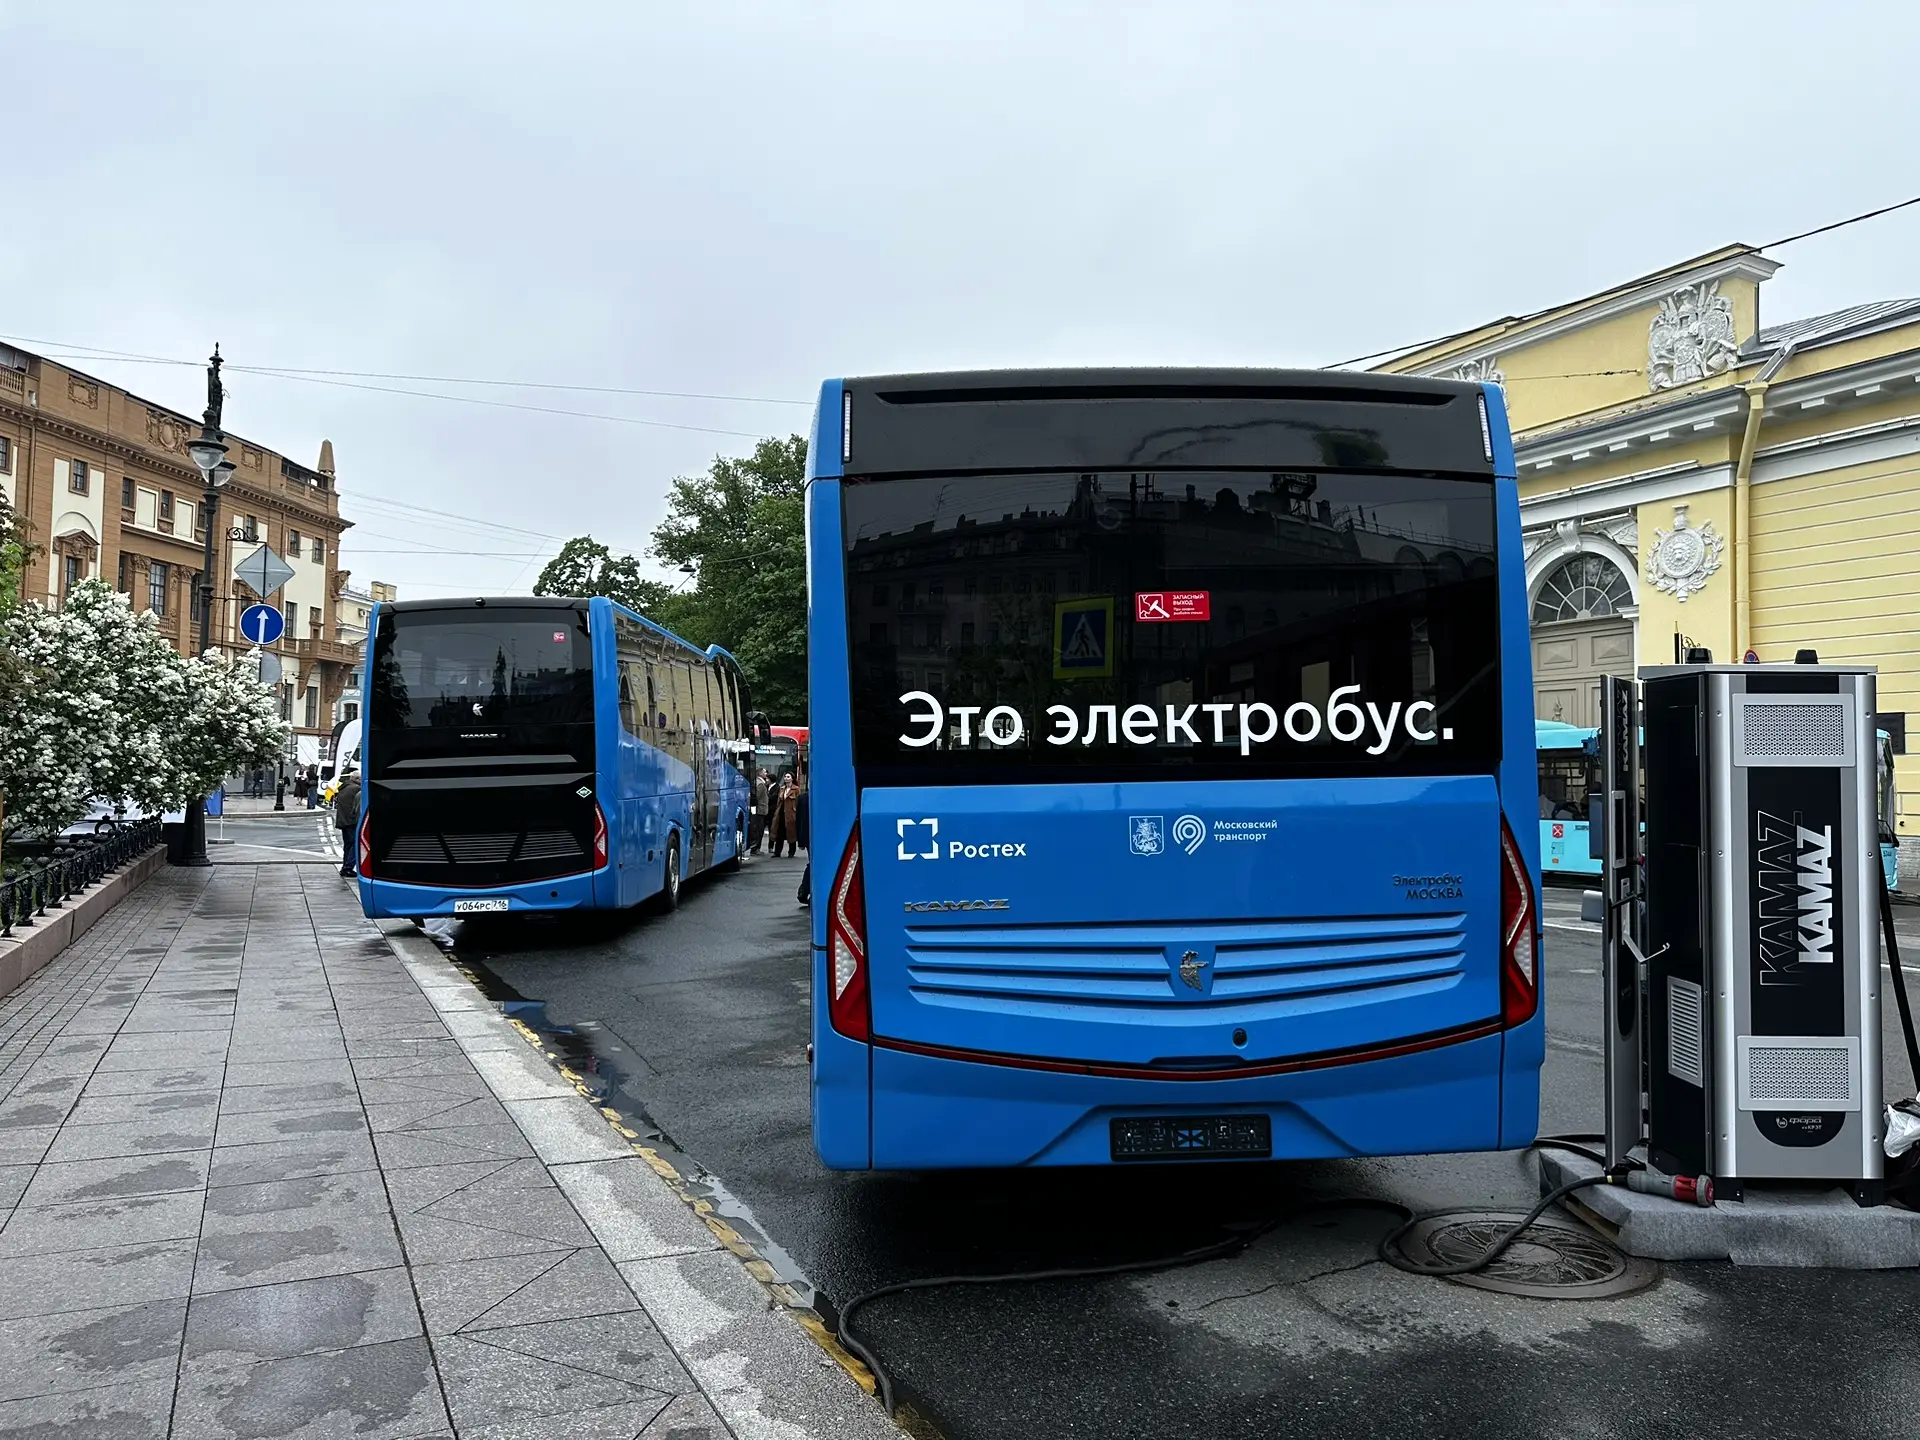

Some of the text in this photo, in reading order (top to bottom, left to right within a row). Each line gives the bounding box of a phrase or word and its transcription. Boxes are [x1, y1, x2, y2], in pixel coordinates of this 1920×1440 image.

[898, 684, 1454, 756] Это электробус.
[1213, 819, 1278, 830] Московский
[1213, 832, 1267, 843] транспорт
[949, 841, 1027, 859] Ростех
[1392, 872, 1463, 886] Электробус
[1406, 887, 1463, 900] МОСКВА
[1757, 810, 1804, 987] KAMAZ
[1796, 825, 1834, 963] KAMAZ
[903, 898, 1010, 912] KAMAZ
